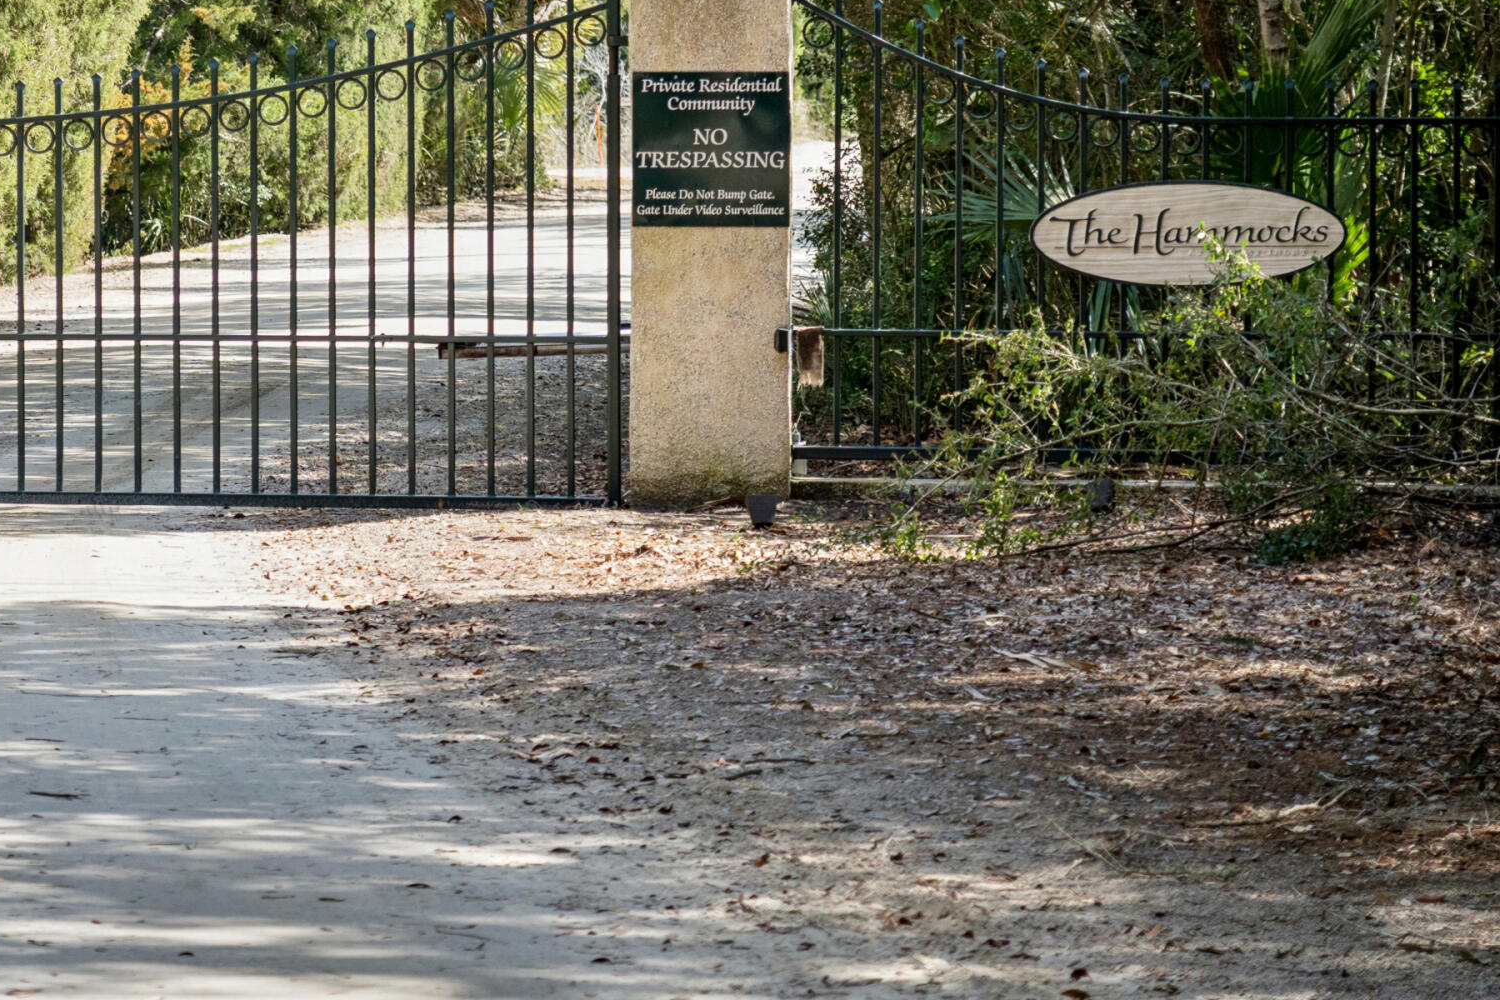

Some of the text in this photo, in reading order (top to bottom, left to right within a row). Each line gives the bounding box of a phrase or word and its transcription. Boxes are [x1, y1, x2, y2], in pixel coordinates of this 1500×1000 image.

[641, 77, 783, 93] Private Residential
[667, 96, 755, 116] Community
[692, 128, 728, 146] NO
[635, 151, 786, 170] TRESPASSING
[645, 187, 775, 204] Please Do Not Bump Gate.
[636, 203, 785, 216] Gate Under Video Surveillance
[1049, 208, 1128, 258] The
